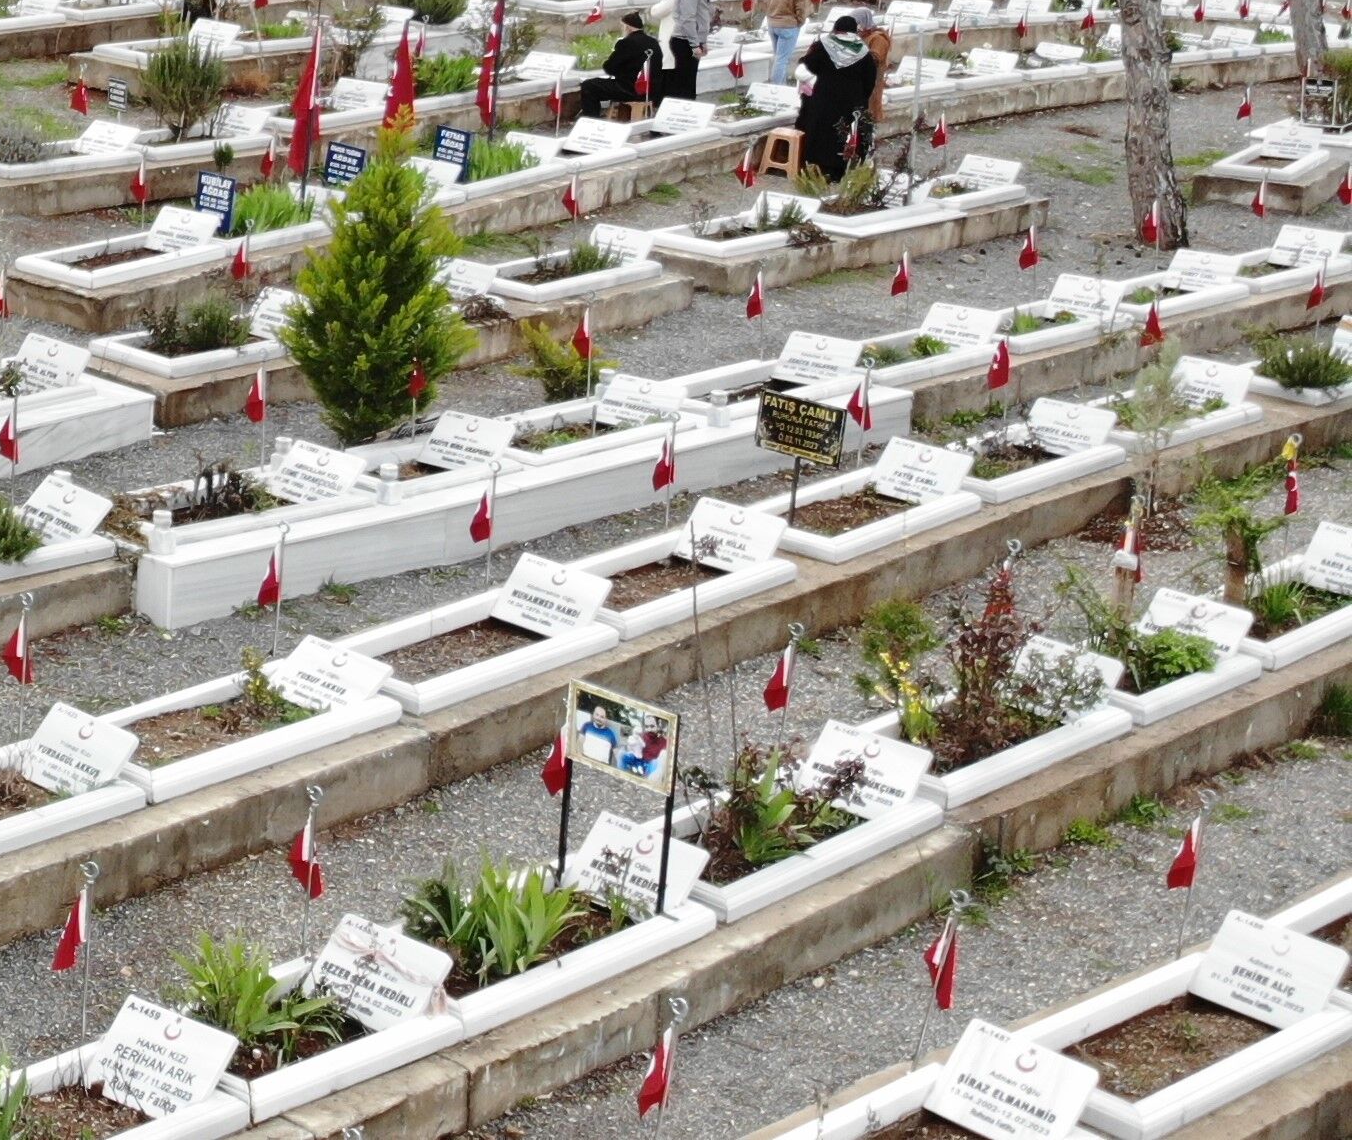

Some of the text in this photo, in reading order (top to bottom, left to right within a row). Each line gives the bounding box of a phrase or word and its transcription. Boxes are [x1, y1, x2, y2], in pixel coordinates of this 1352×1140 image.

[799, 404, 836, 423] ÇAMLI
[127, 1002, 161, 1020] A-1459
[166, 1066, 197, 1086] ARIK
